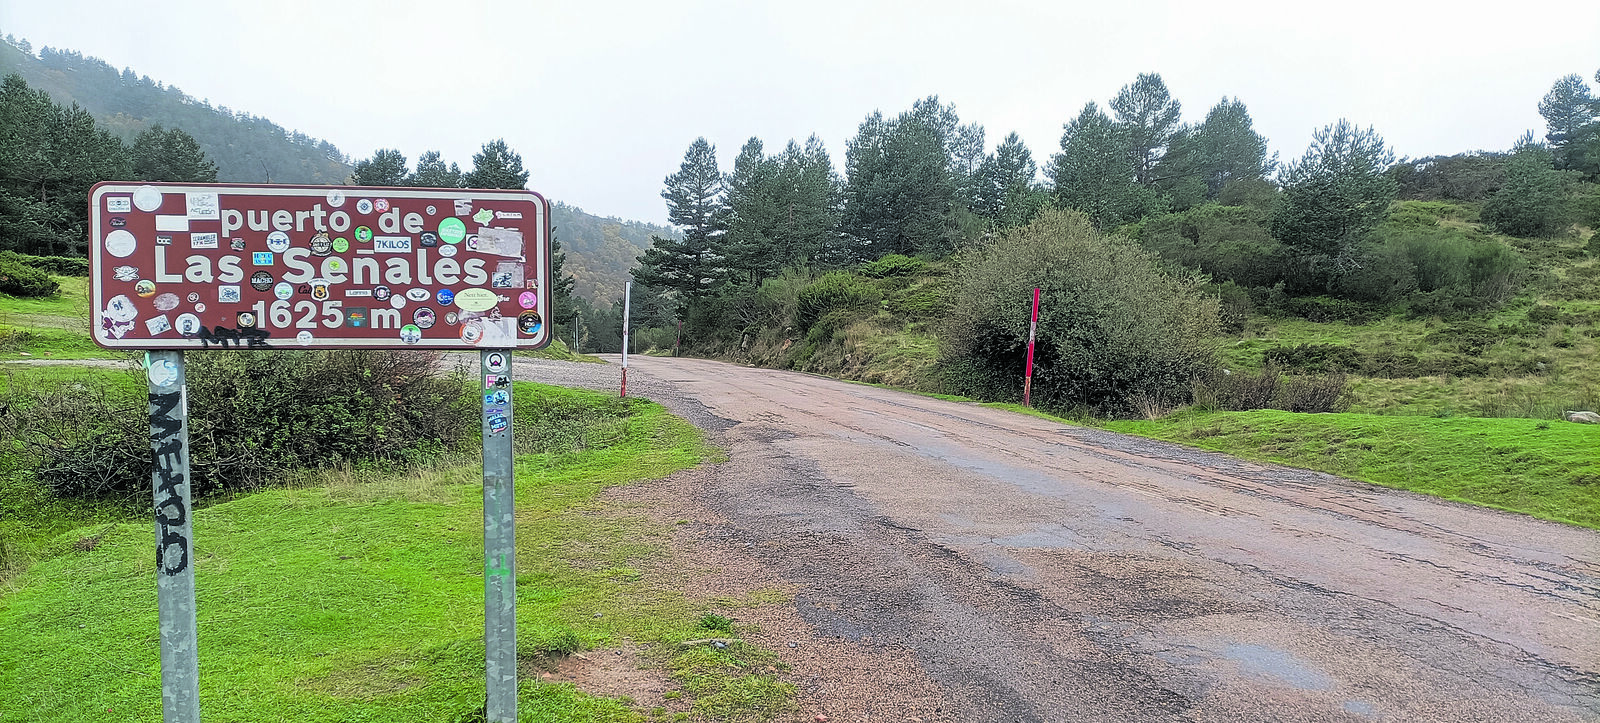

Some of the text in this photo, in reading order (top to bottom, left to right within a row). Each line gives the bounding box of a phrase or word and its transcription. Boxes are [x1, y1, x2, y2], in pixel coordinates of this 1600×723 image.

[221, 204, 351, 237] puerto
[378, 207, 424, 234] de
[376, 240, 409, 249] 7KILOS
[155, 245, 488, 286] Las Señales
[252, 300, 401, 329] 1625 m
